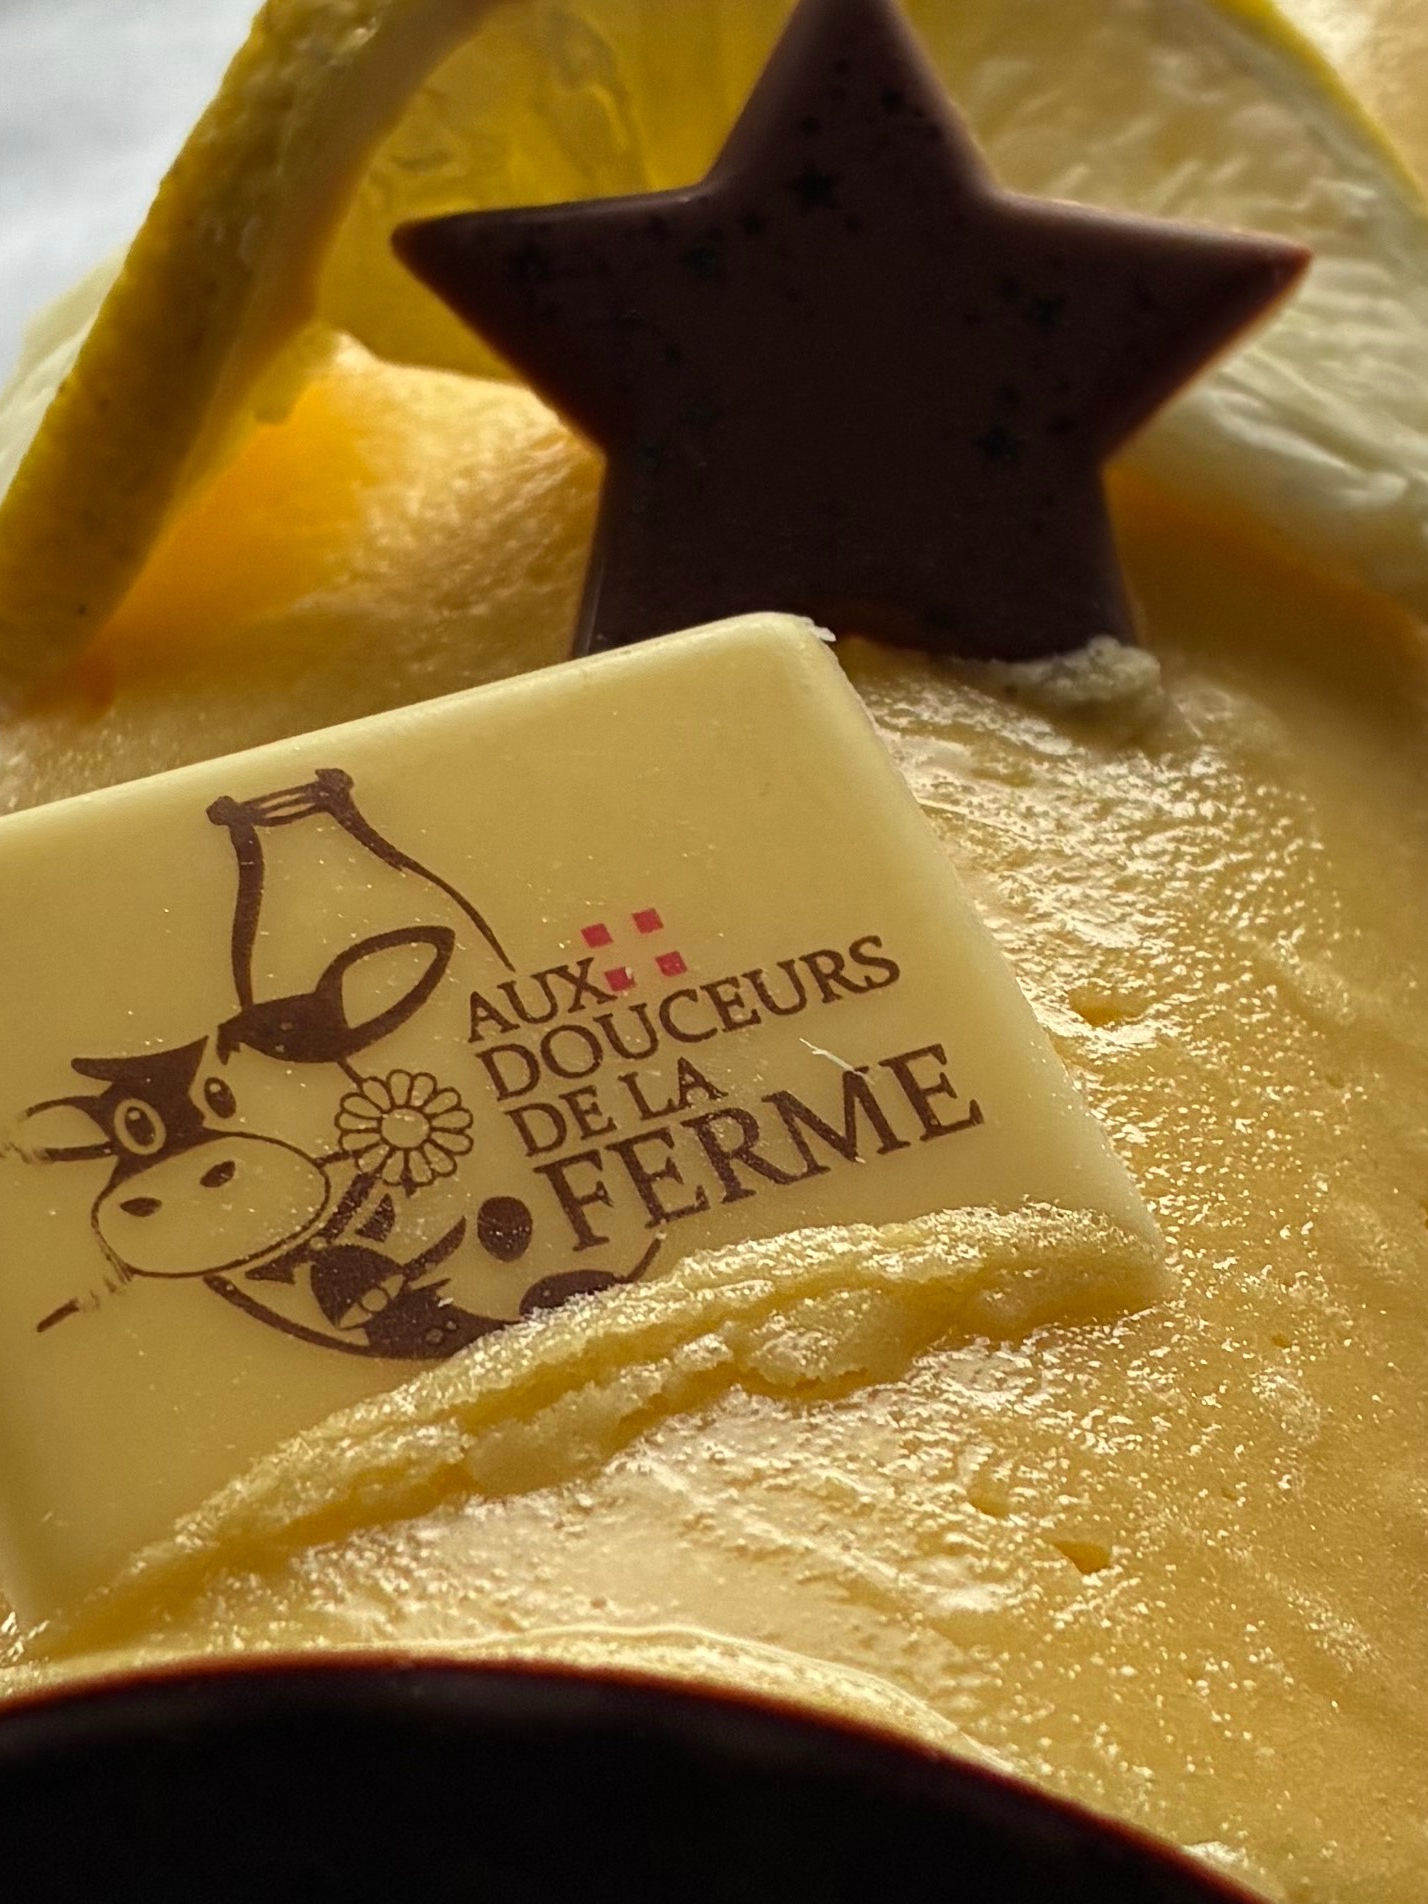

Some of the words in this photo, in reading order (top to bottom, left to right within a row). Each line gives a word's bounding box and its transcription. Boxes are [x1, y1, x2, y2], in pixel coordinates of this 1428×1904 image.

[468, 957, 616, 1043] AUX
[476, 935, 900, 1101] DOUCEURS
[506, 1085, 615, 1157] DE
[618, 1056, 727, 1121] LA
[534, 1044, 984, 1252] FERME
